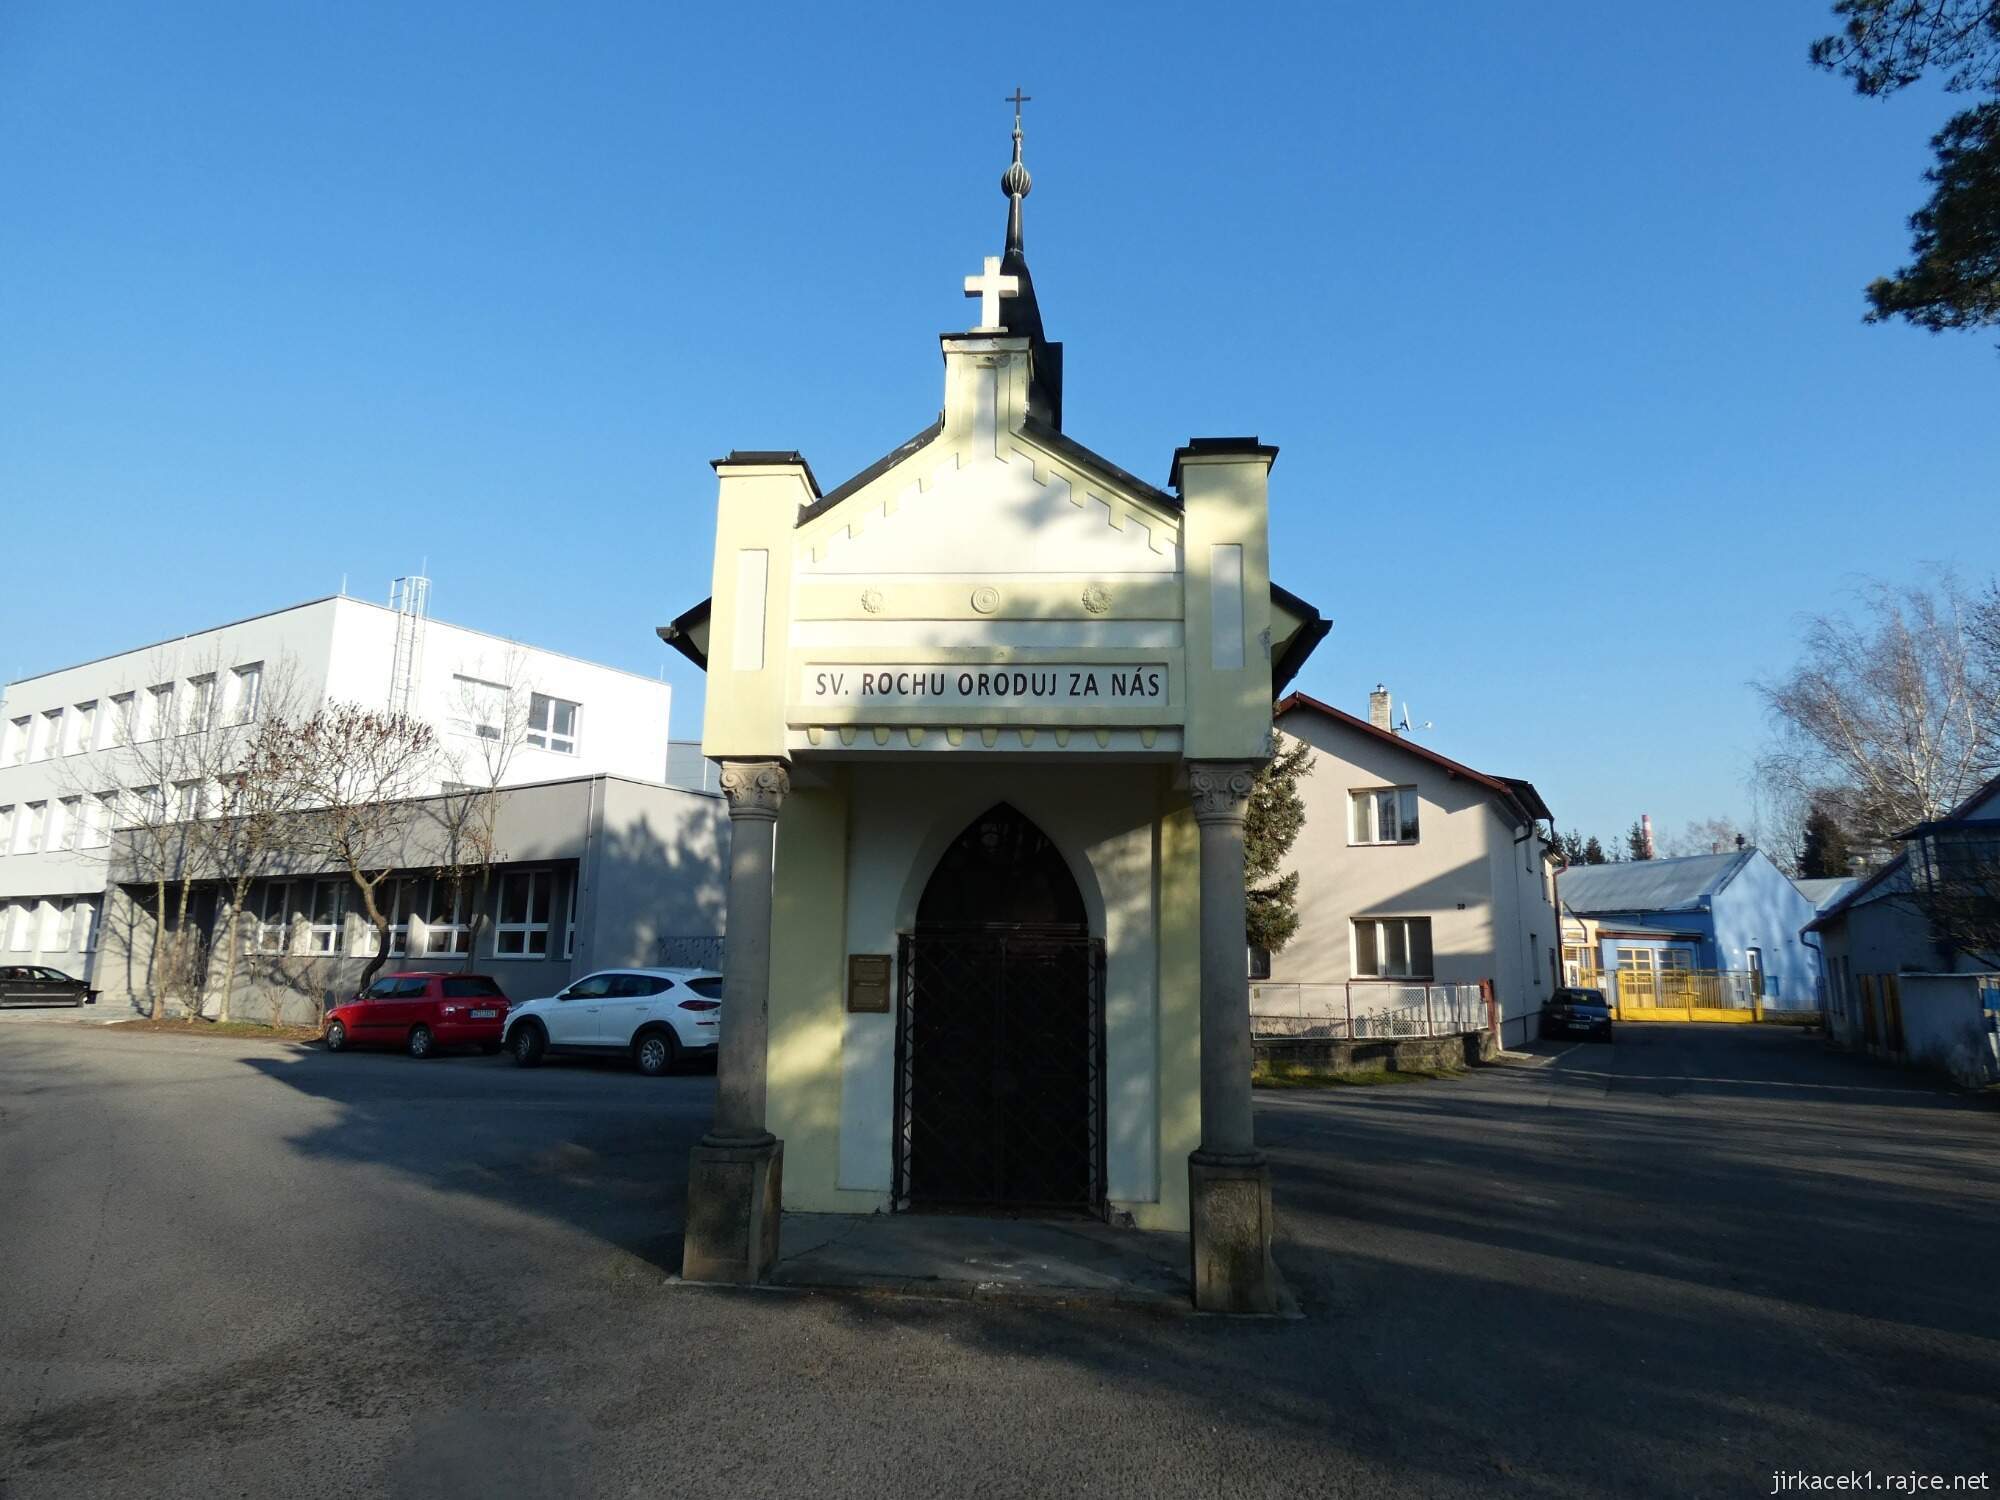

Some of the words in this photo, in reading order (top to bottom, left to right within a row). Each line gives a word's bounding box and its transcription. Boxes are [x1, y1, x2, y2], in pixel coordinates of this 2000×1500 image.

[815, 672, 849, 696] SV.
[861, 672, 946, 697] ROCHU
[957, 672, 1057, 697] ORODUJ
[1069, 672, 1099, 697] ZA
[1111, 667, 1160, 697] NÁS
